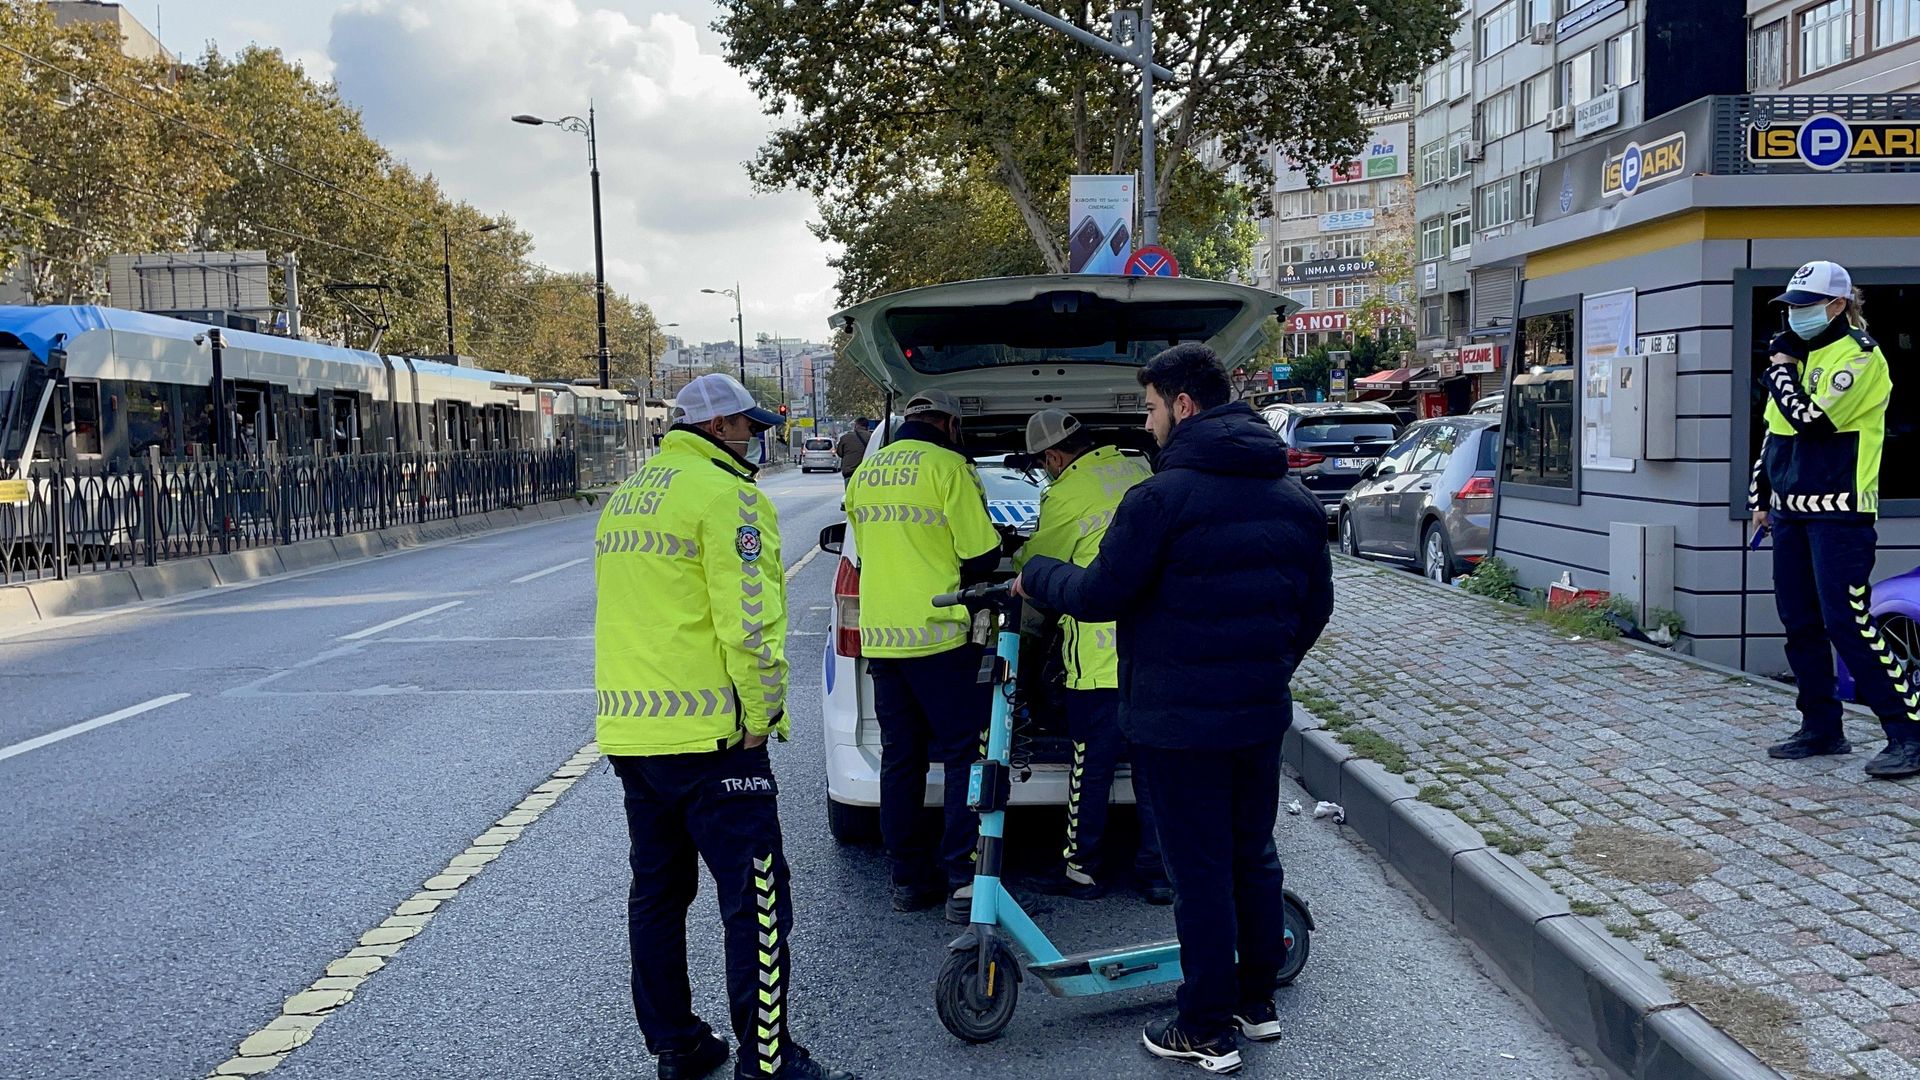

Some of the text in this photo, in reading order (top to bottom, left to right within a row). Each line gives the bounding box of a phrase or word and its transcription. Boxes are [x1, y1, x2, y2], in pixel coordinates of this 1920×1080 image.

[1371, 142, 1394, 156] Ria
[1329, 211, 1364, 223] SES
[1338, 260, 1375, 273] GROUP
[1295, 317, 1307, 331] 9.
[1666, 334, 1675, 351] 26
[1338, 459, 1347, 467] 34
